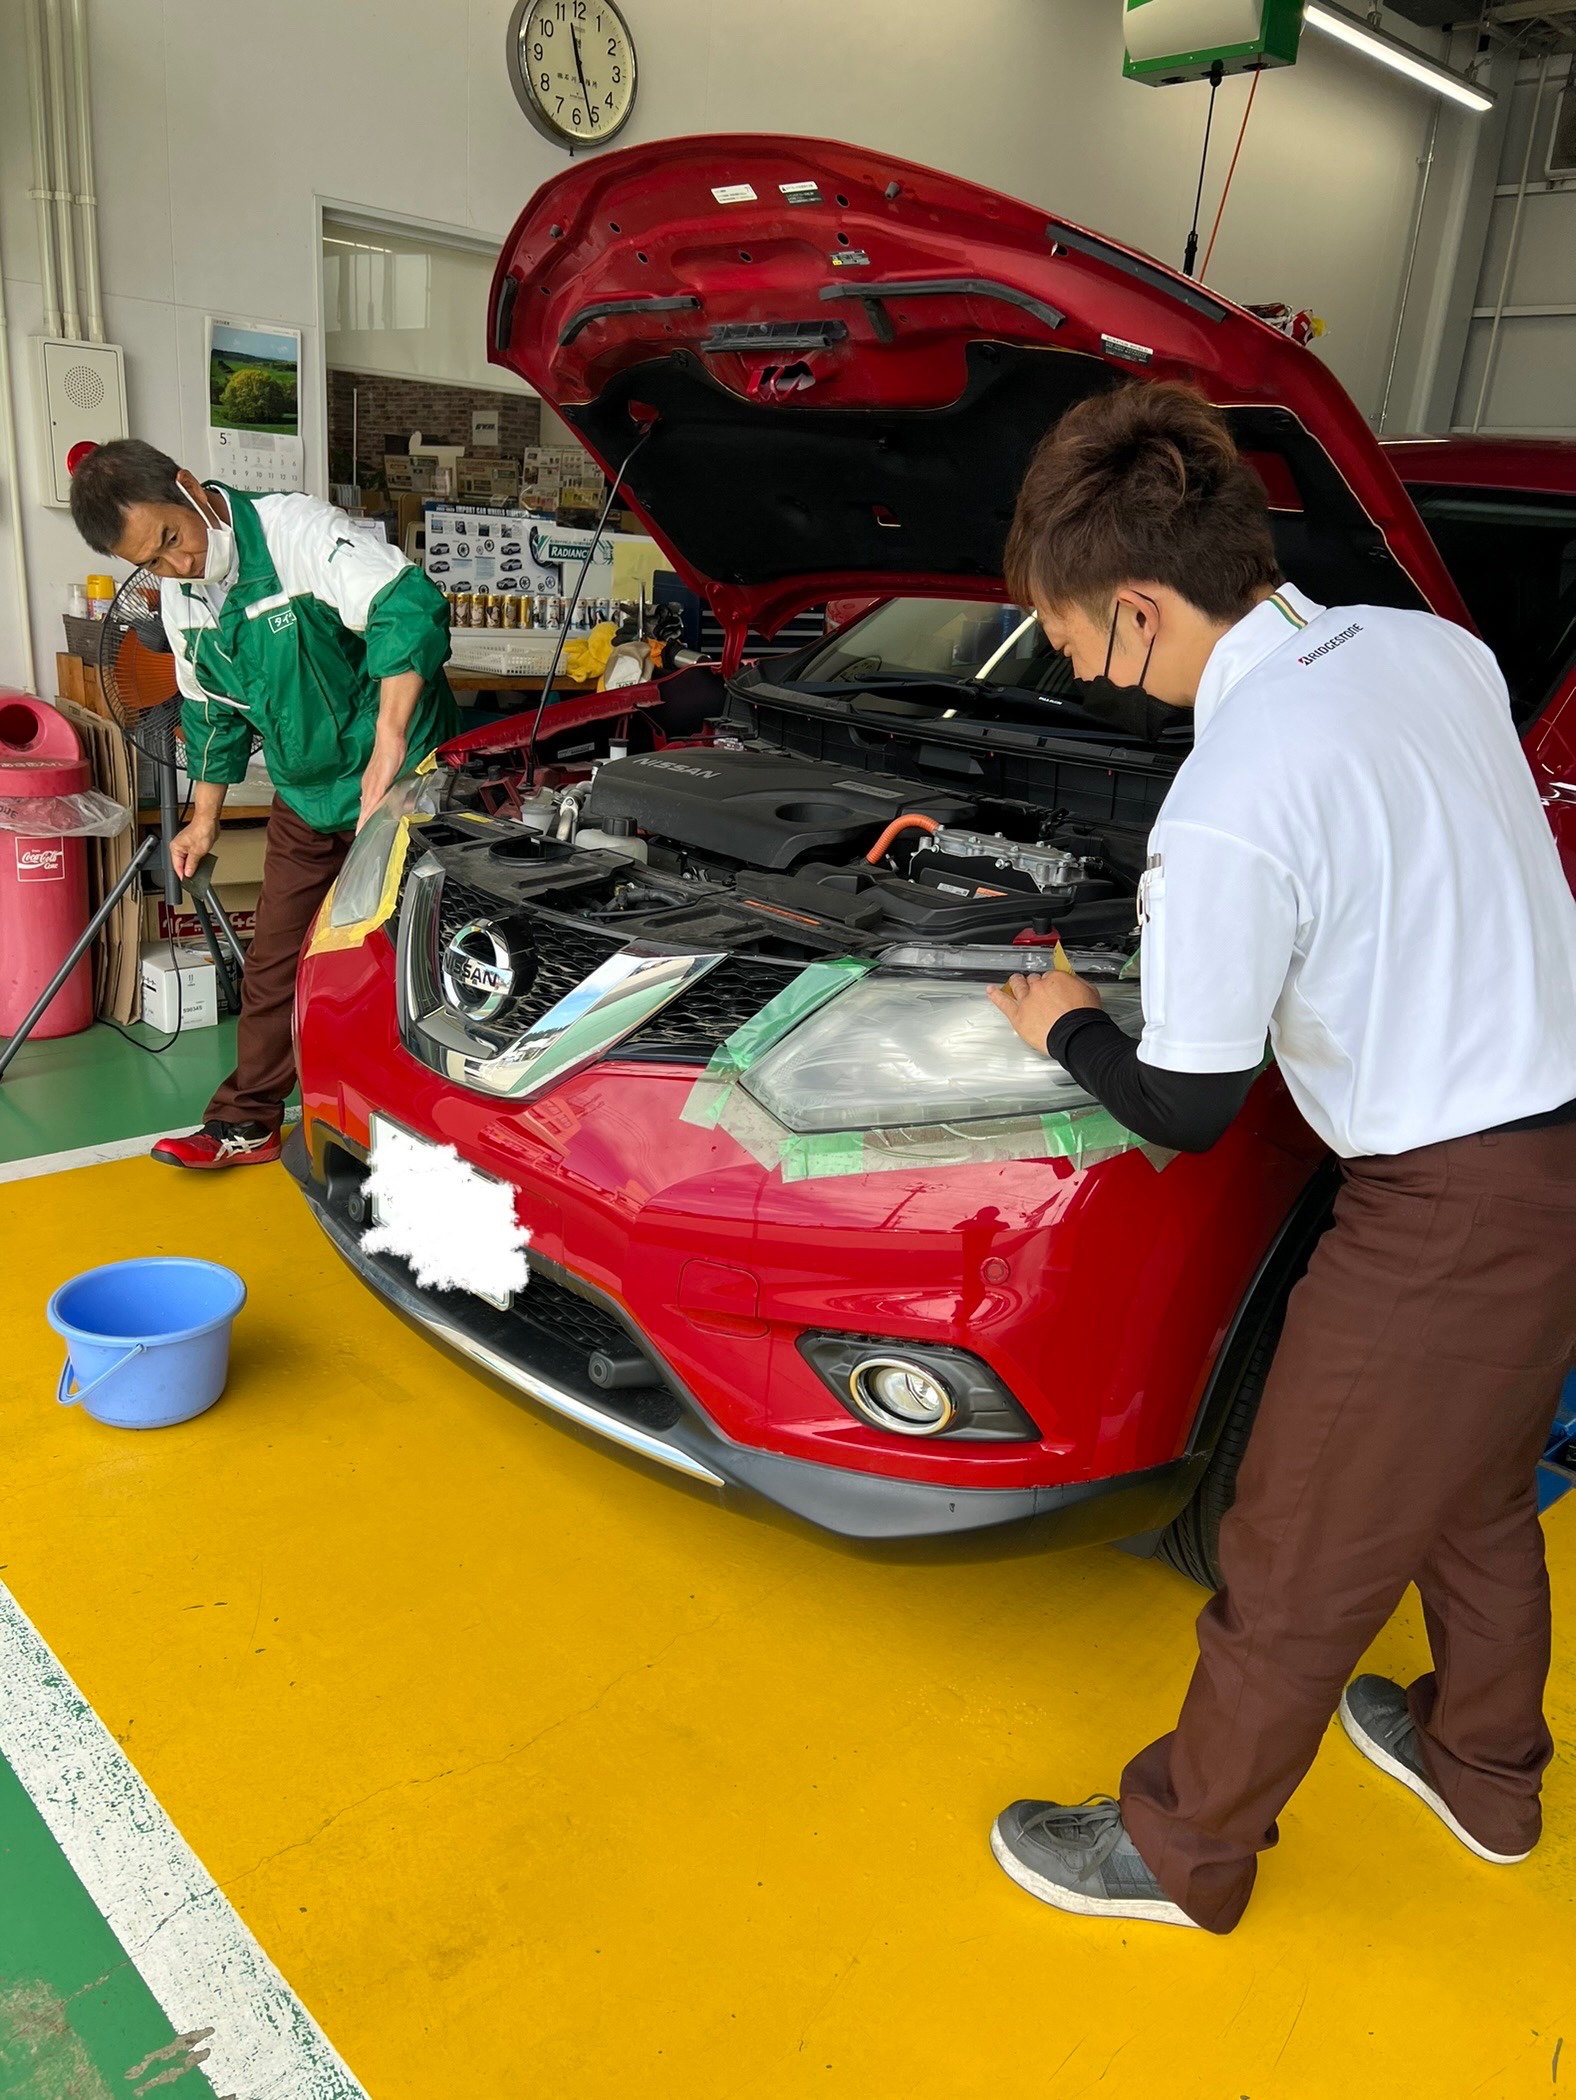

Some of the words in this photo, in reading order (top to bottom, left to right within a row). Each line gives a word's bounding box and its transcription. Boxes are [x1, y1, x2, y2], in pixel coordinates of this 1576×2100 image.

[555, 2, 566, 21] 11
[573, 1, 586, 20] 12
[539, 18, 554, 37] 10
[596, 15, 601, 32] 1
[533, 43, 543, 61] 9
[607, 38, 617, 56] 2
[540, 73, 550, 91] 8
[611, 66, 621, 83] 3
[555, 95, 565, 113] 7
[604, 91, 613, 109] 4
[572, 108, 581, 125] 6
[591, 106, 600, 123] 5
[219, 432, 227, 445] 5
[551, 546, 589, 558] RADIANC
[1298, 623, 1364, 666] BRIDGESTONE
[633, 758, 722, 779] NISSAN
[444, 951, 498, 988] NISSAN
